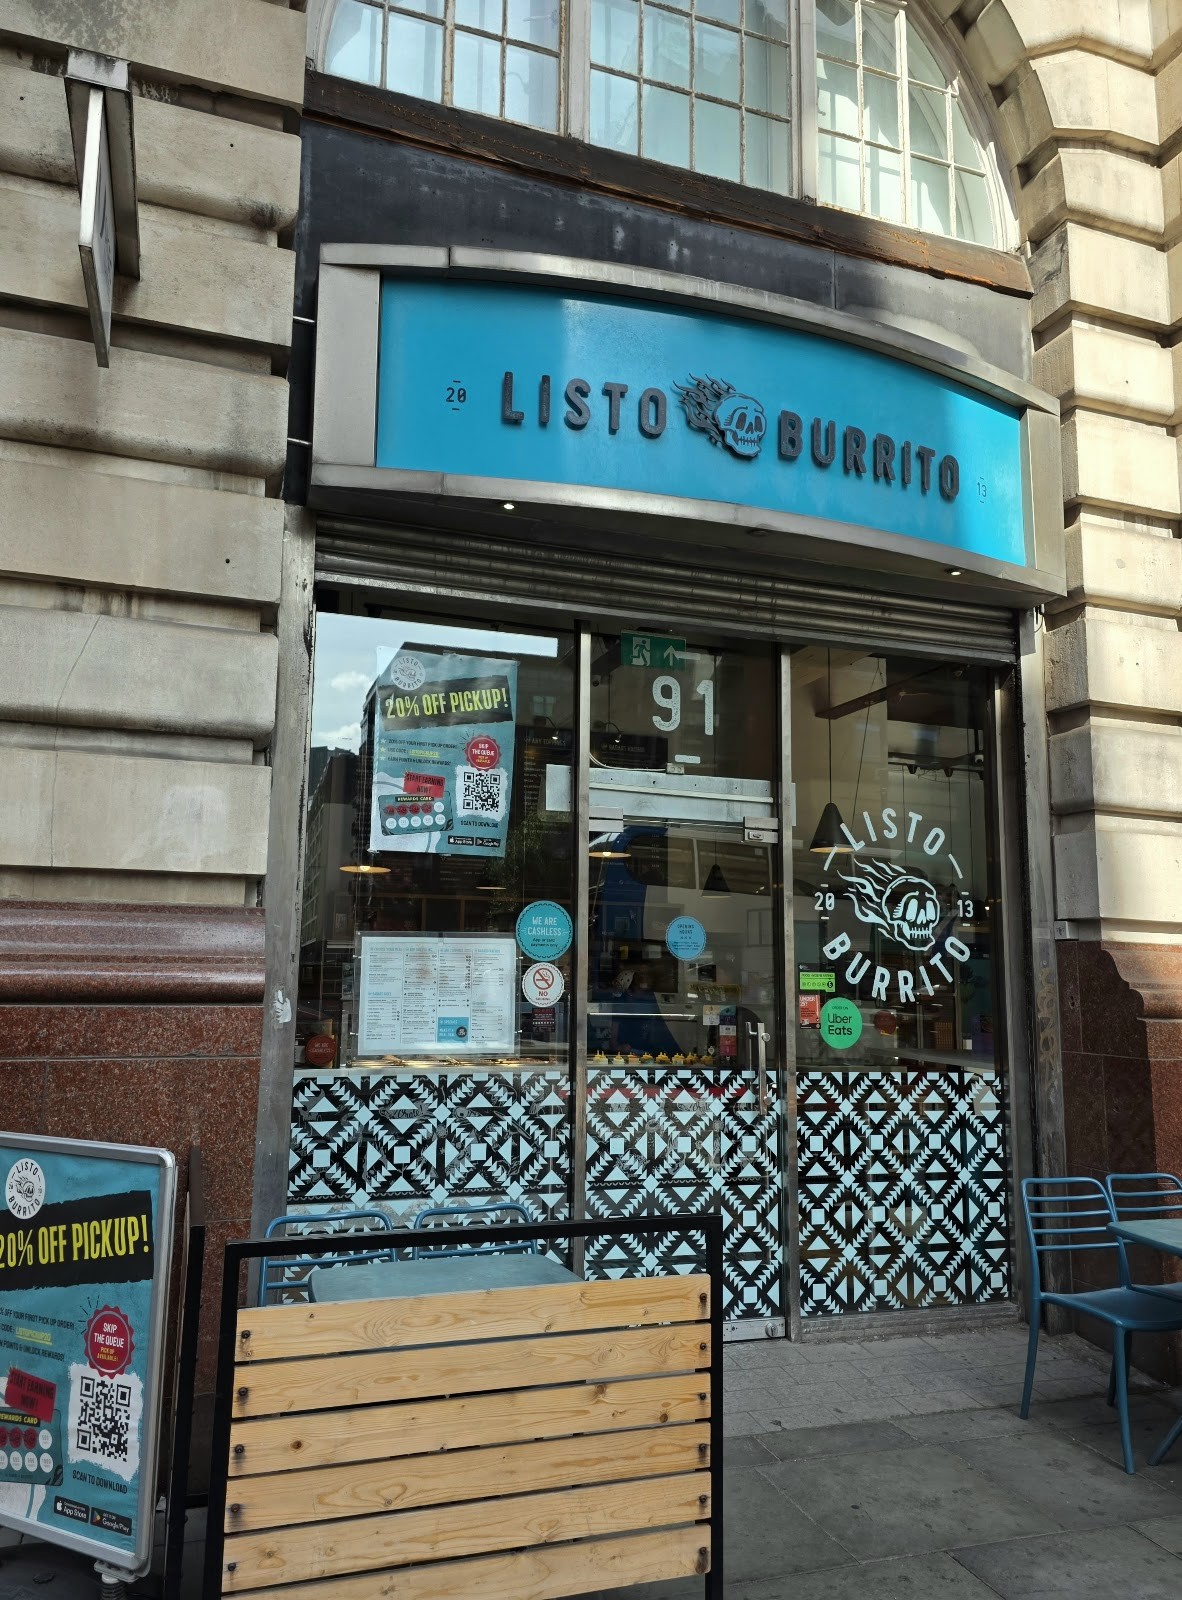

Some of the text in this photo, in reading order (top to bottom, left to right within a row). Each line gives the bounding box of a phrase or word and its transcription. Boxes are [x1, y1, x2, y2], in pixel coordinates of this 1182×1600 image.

[445, 387, 467, 404] 20
[501, 371, 960, 500] LISTO BURRITO
[977, 482, 987, 498] 13
[399, 656, 419, 668] LISTO
[394, 676, 422, 689] BURRITO
[385, 687, 508, 719] 20% OFF PICKUP!
[652, 675, 714, 736] 91
[840, 807, 946, 855] LISTO
[814, 892, 835, 911] 20
[957, 900, 974, 918] 13
[532, 916, 557, 926] WE ARE
[528, 927, 562, 936] CASHLESS
[823, 932, 970, 1003] BURRITO
[828, 1013, 852, 1024] Uber
[828, 1025, 852, 1036] Eats
[16, 1161, 39, 1176] LISTO
[8, 1195, 40, 1217] BURRITO
[38, 1224, 67, 1265] OFF
[71, 1214, 149, 1261] PICKUP!
[13, 1310, 25, 1320] YOUR
[25, 1312, 38, 1322] FIRST
[38, 1315, 49, 1325] PICK
[50, 1318, 57, 1326] UP
[57, 1319, 75, 1330] ORDER!
[103, 1322, 118, 1334] SKIP
[3, 1340, 18, 1350] POINTS
[23, 1345, 40, 1356] UNLOCK
[94, 1332, 125, 1348] THE QUEUE
[23, 1416, 38, 1424] CARD
[72, 1469, 128, 1494] SCAN TO DOWNLOAD
[63, 1506, 74, 1516] App
[102, 1517, 119, 1530] Google
